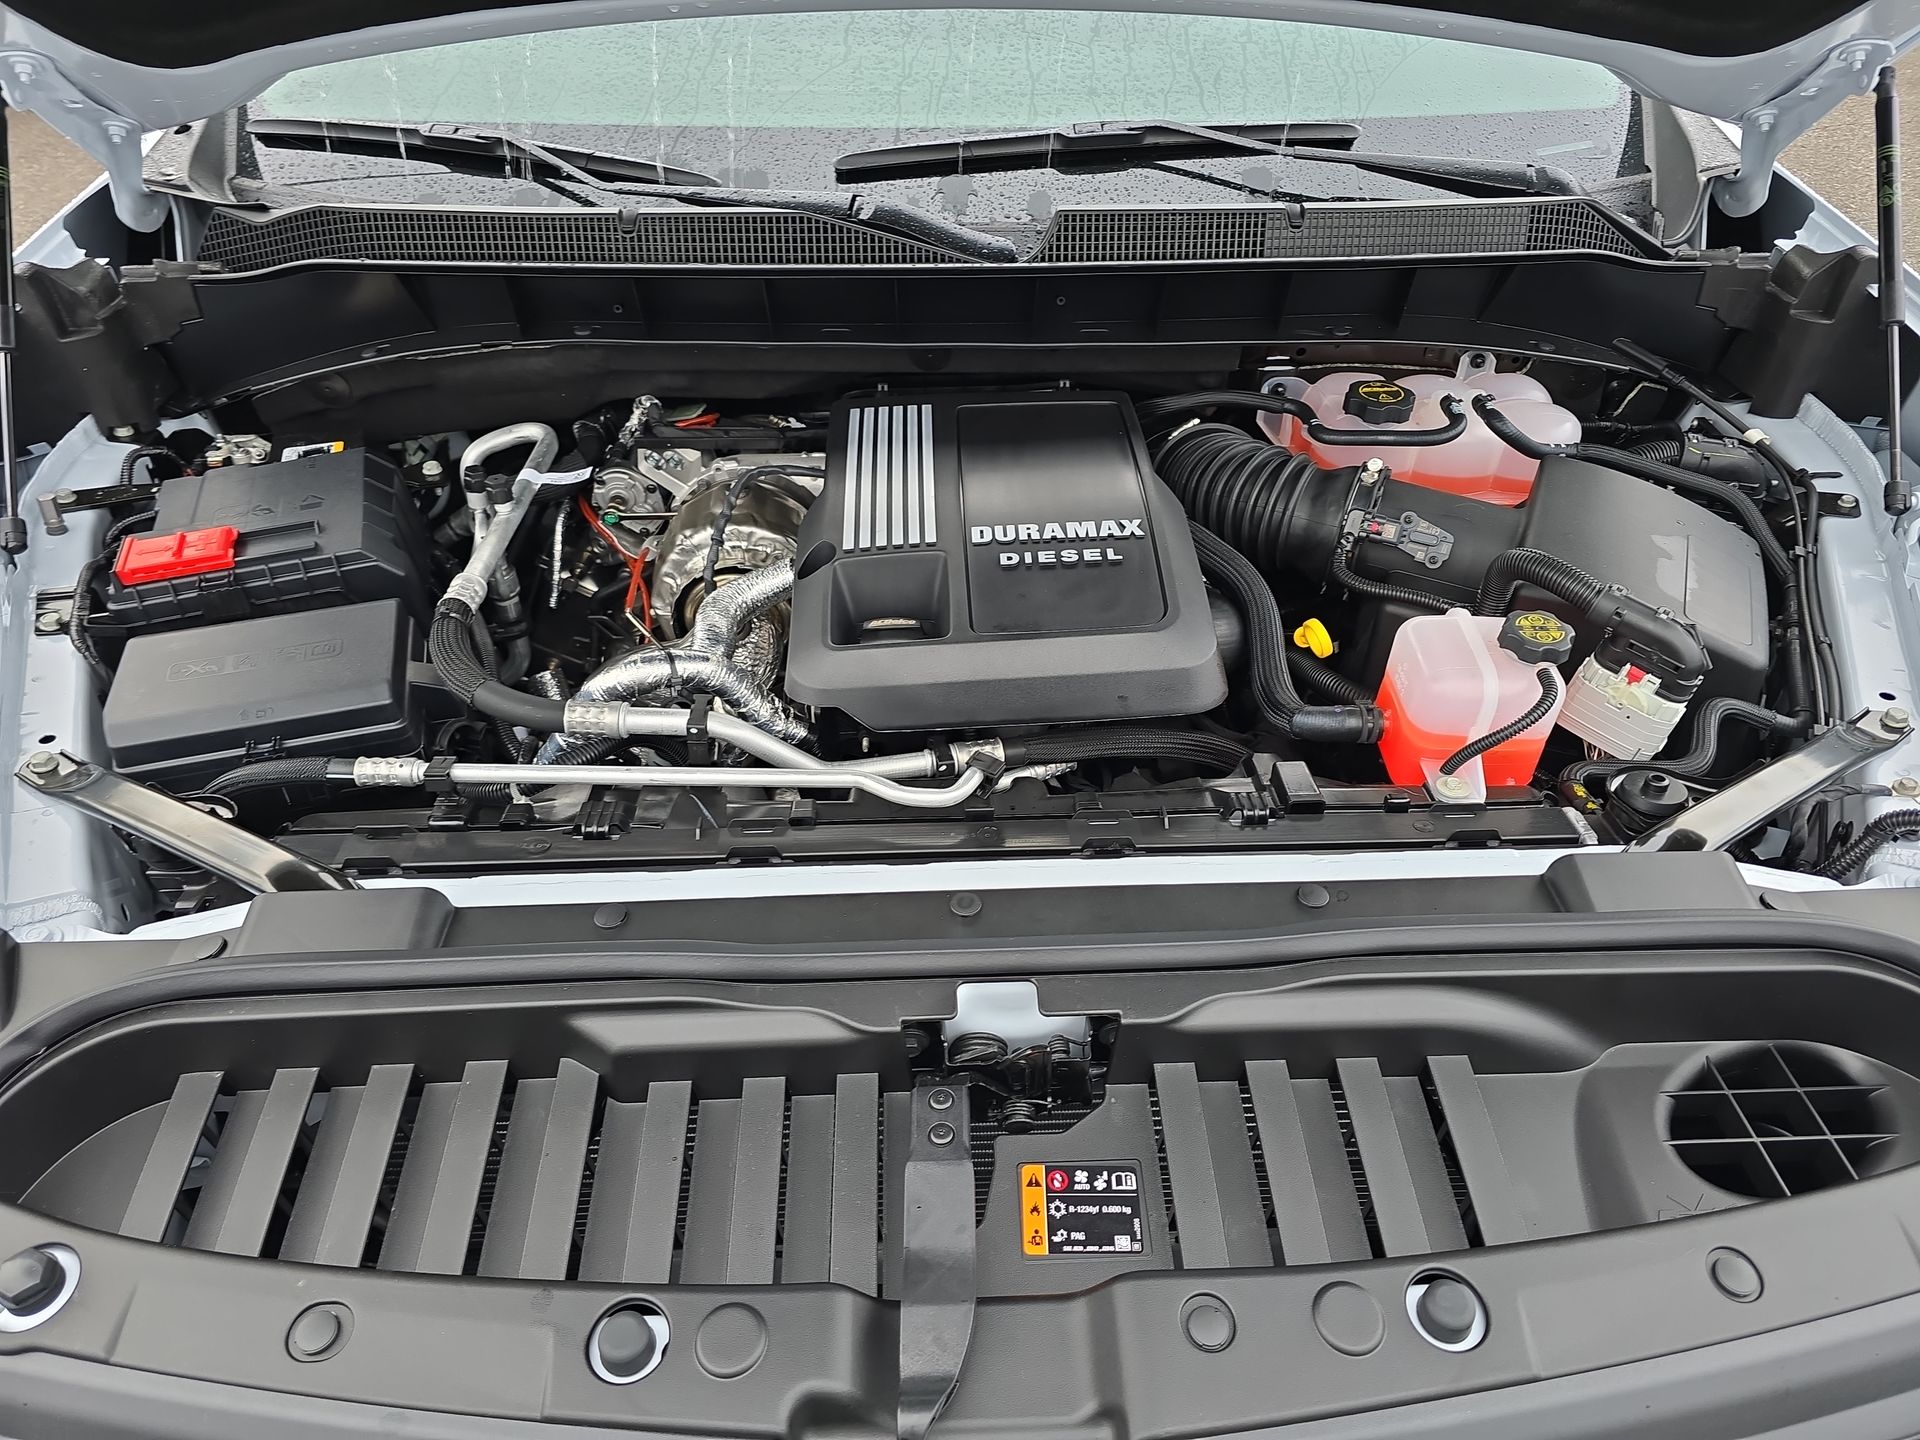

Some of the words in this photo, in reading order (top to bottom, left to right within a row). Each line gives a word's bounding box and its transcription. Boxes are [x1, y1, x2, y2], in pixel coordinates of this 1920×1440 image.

[970, 519, 1145, 545] DURAMAX
[1000, 547, 1124, 568] DIESEL
[1070, 1231, 1086, 1240] PAG
